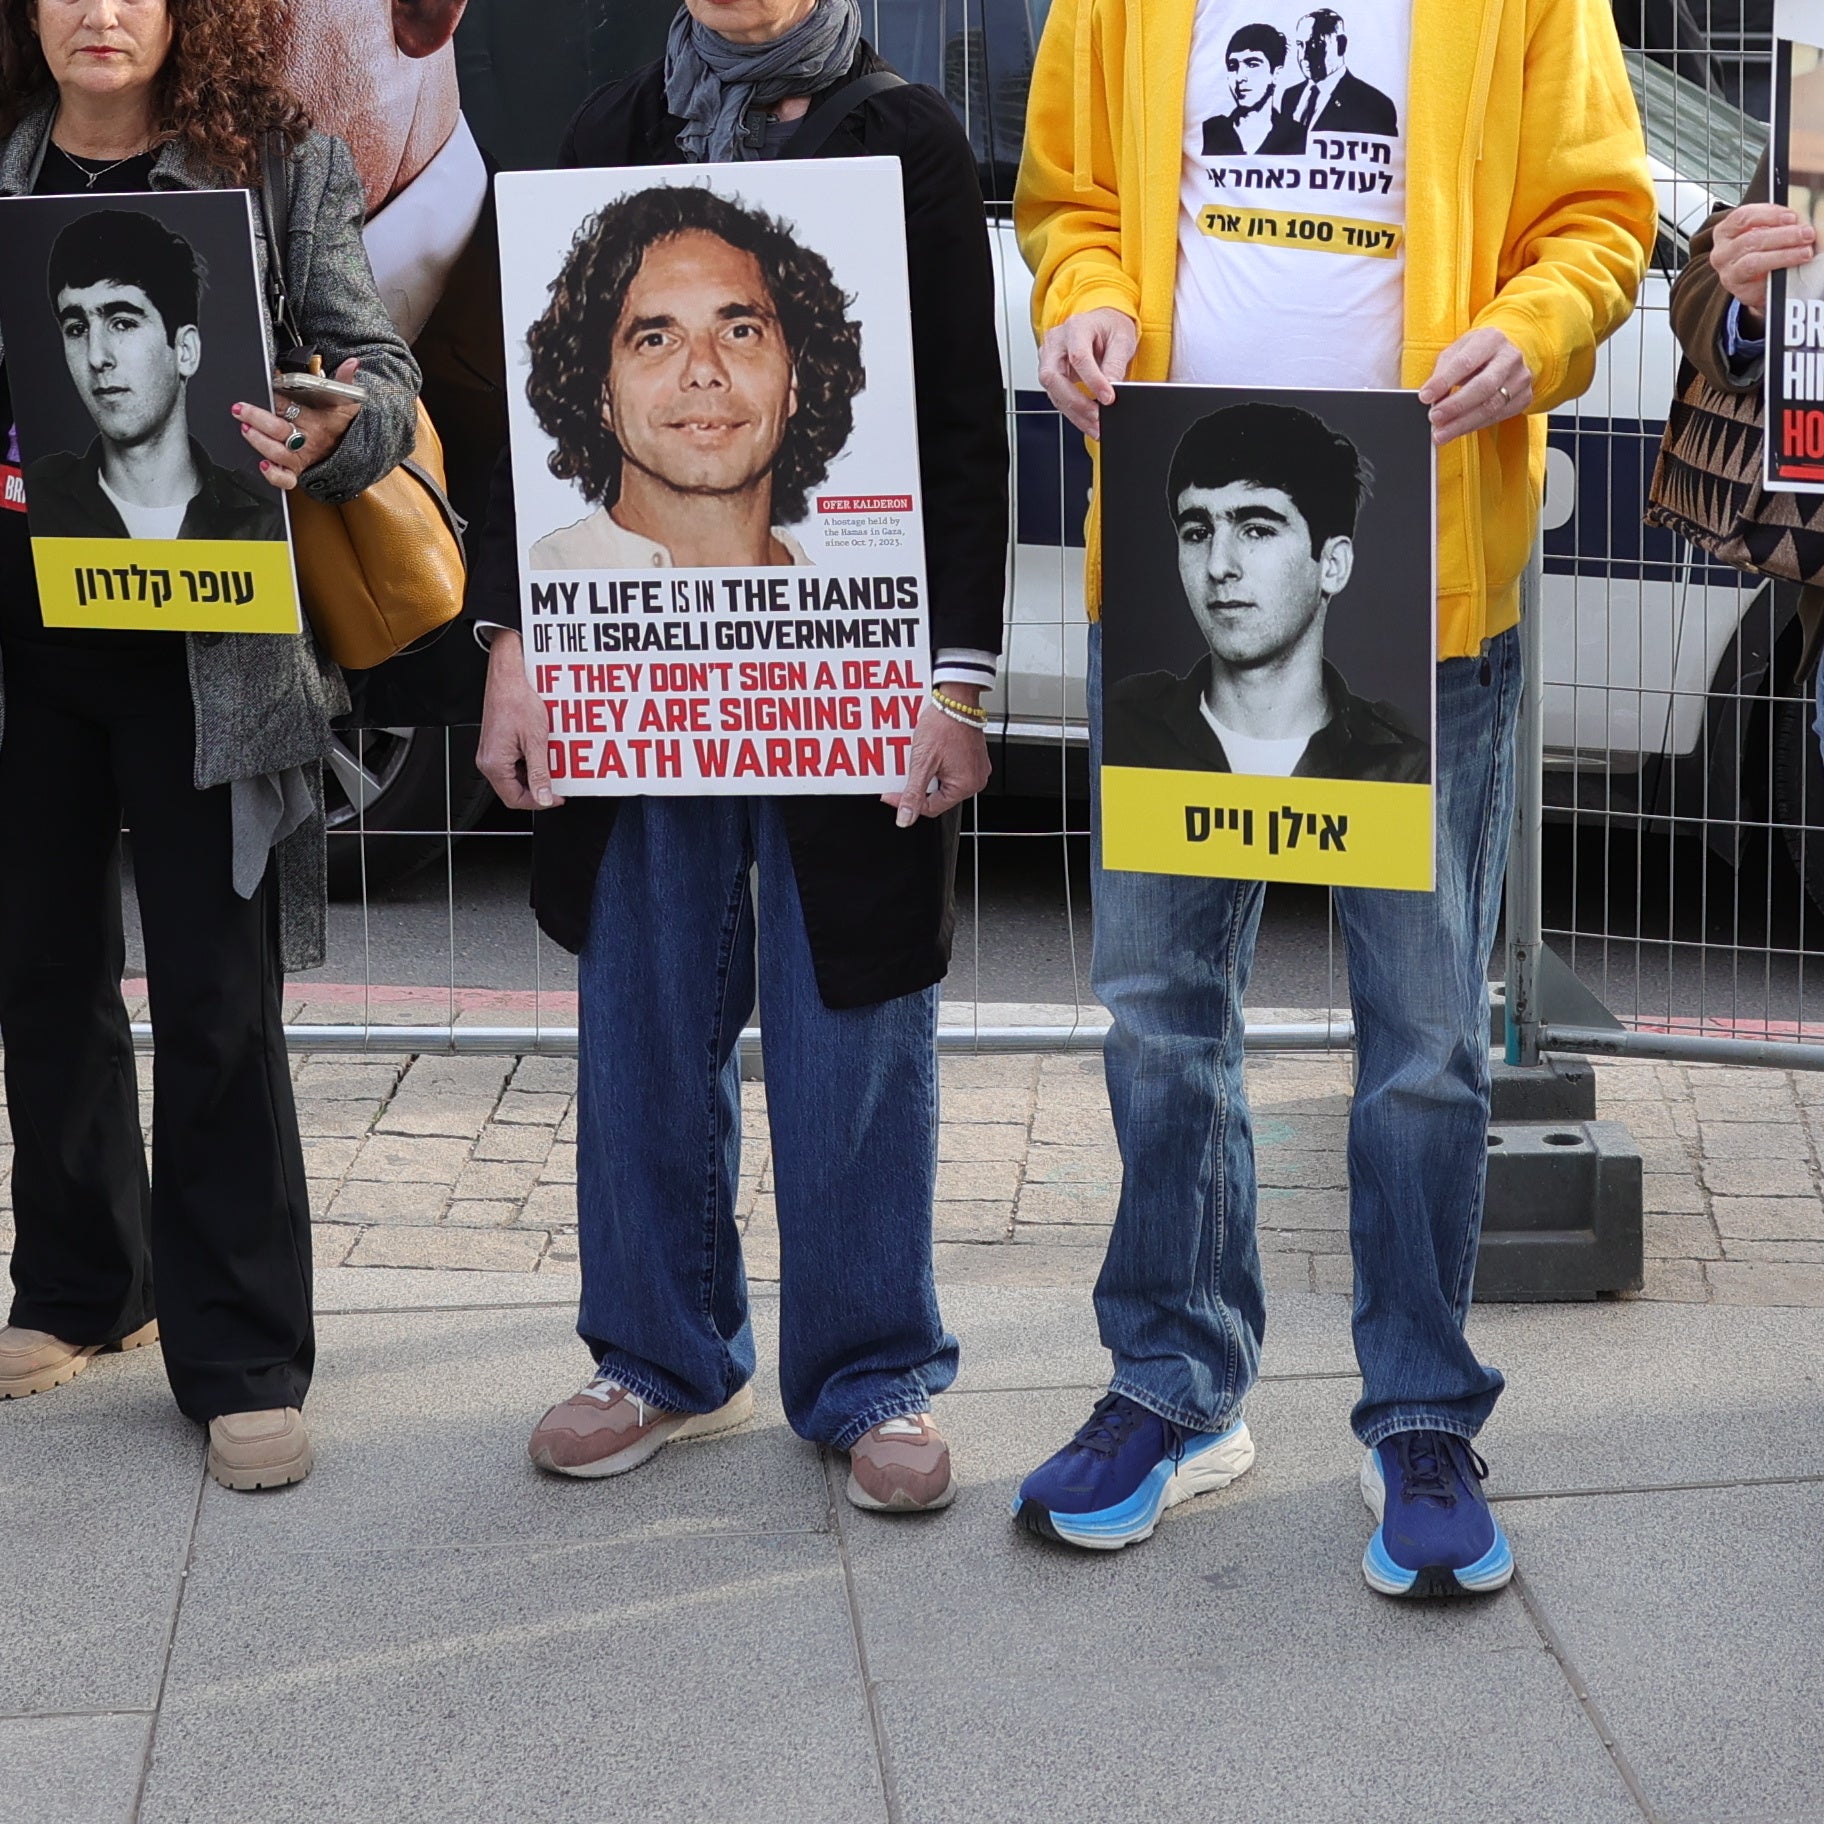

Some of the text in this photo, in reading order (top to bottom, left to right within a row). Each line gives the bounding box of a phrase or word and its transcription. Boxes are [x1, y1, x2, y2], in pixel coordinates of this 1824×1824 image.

[1313, 138, 1391, 165] תיזכר
[1206, 167, 1393, 195] לעולם כאחראי
[1205, 213, 1396, 250] לעוד 100 רון ארד
[823, 499, 907, 510] OFER KALDERON
[832, 518, 866, 526] hostage
[868, 517, 887, 525] held
[890, 517, 900, 526] by
[825, 528, 905, 536] the Hamas in Gaza,
[869, 539, 877, 547] 7,
[75, 564, 254, 608] עופר קלדרון
[531, 576, 919, 615] MY LIFE IS IN THE HANDS
[533, 618, 920, 653] OF THE ISRAELI GOVERNMENT
[536, 660, 923, 693] IF THEY DON'T SIGN A DEAL
[543, 695, 924, 733] THEY ARE SIGNING MY
[547, 736, 911, 779] DEATH WARRANT
[1184, 805, 1348, 855] אילן וייס
